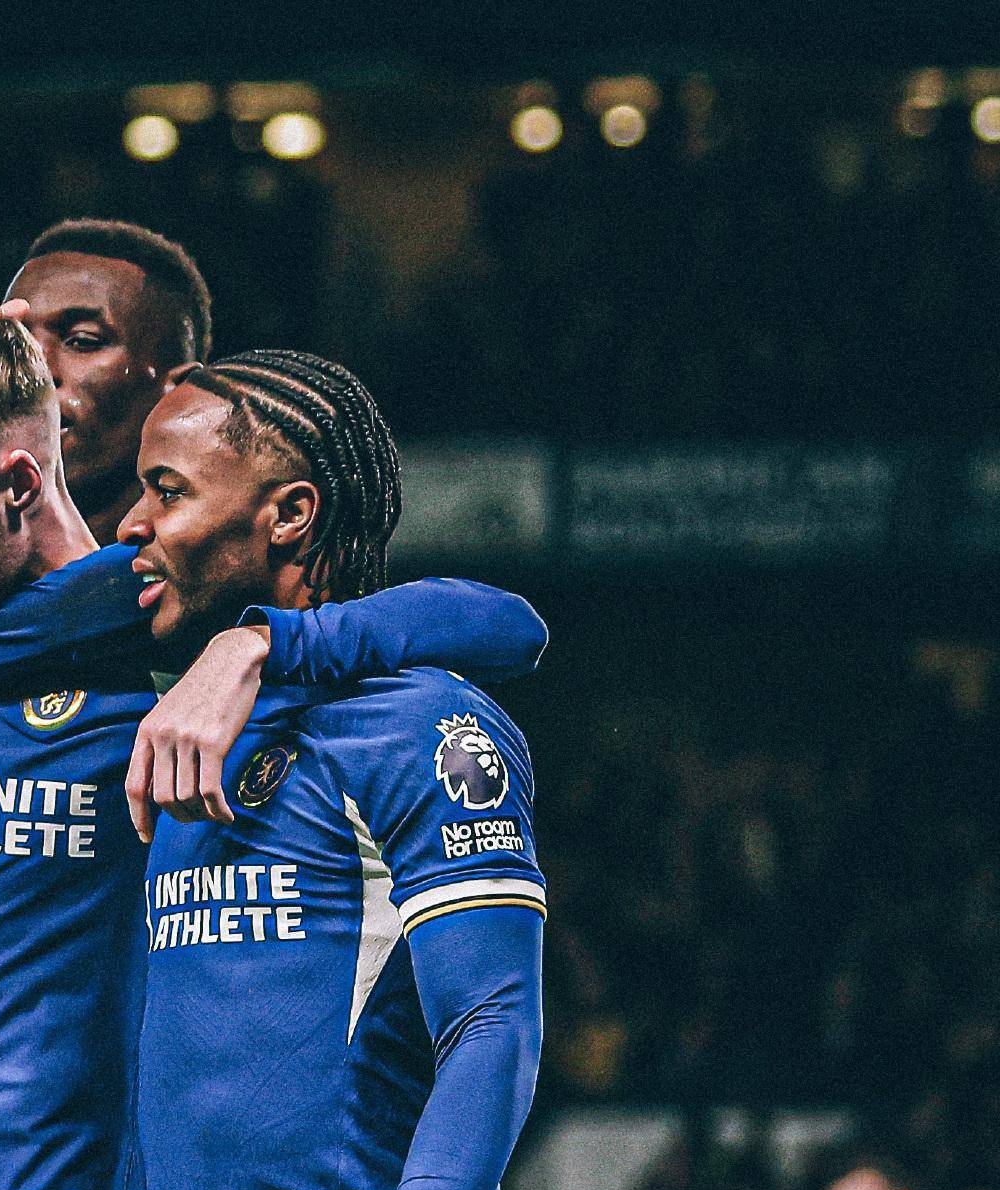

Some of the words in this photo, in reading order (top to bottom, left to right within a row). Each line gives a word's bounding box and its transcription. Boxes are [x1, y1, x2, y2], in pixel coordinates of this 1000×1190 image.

[441, 823, 471, 841] No
[474, 821, 515, 836] room
[445, 840, 473, 858] for
[476, 836, 523, 852] racism
[155, 864, 301, 909] INFINITE
[152, 907, 307, 953] ATHLETE
